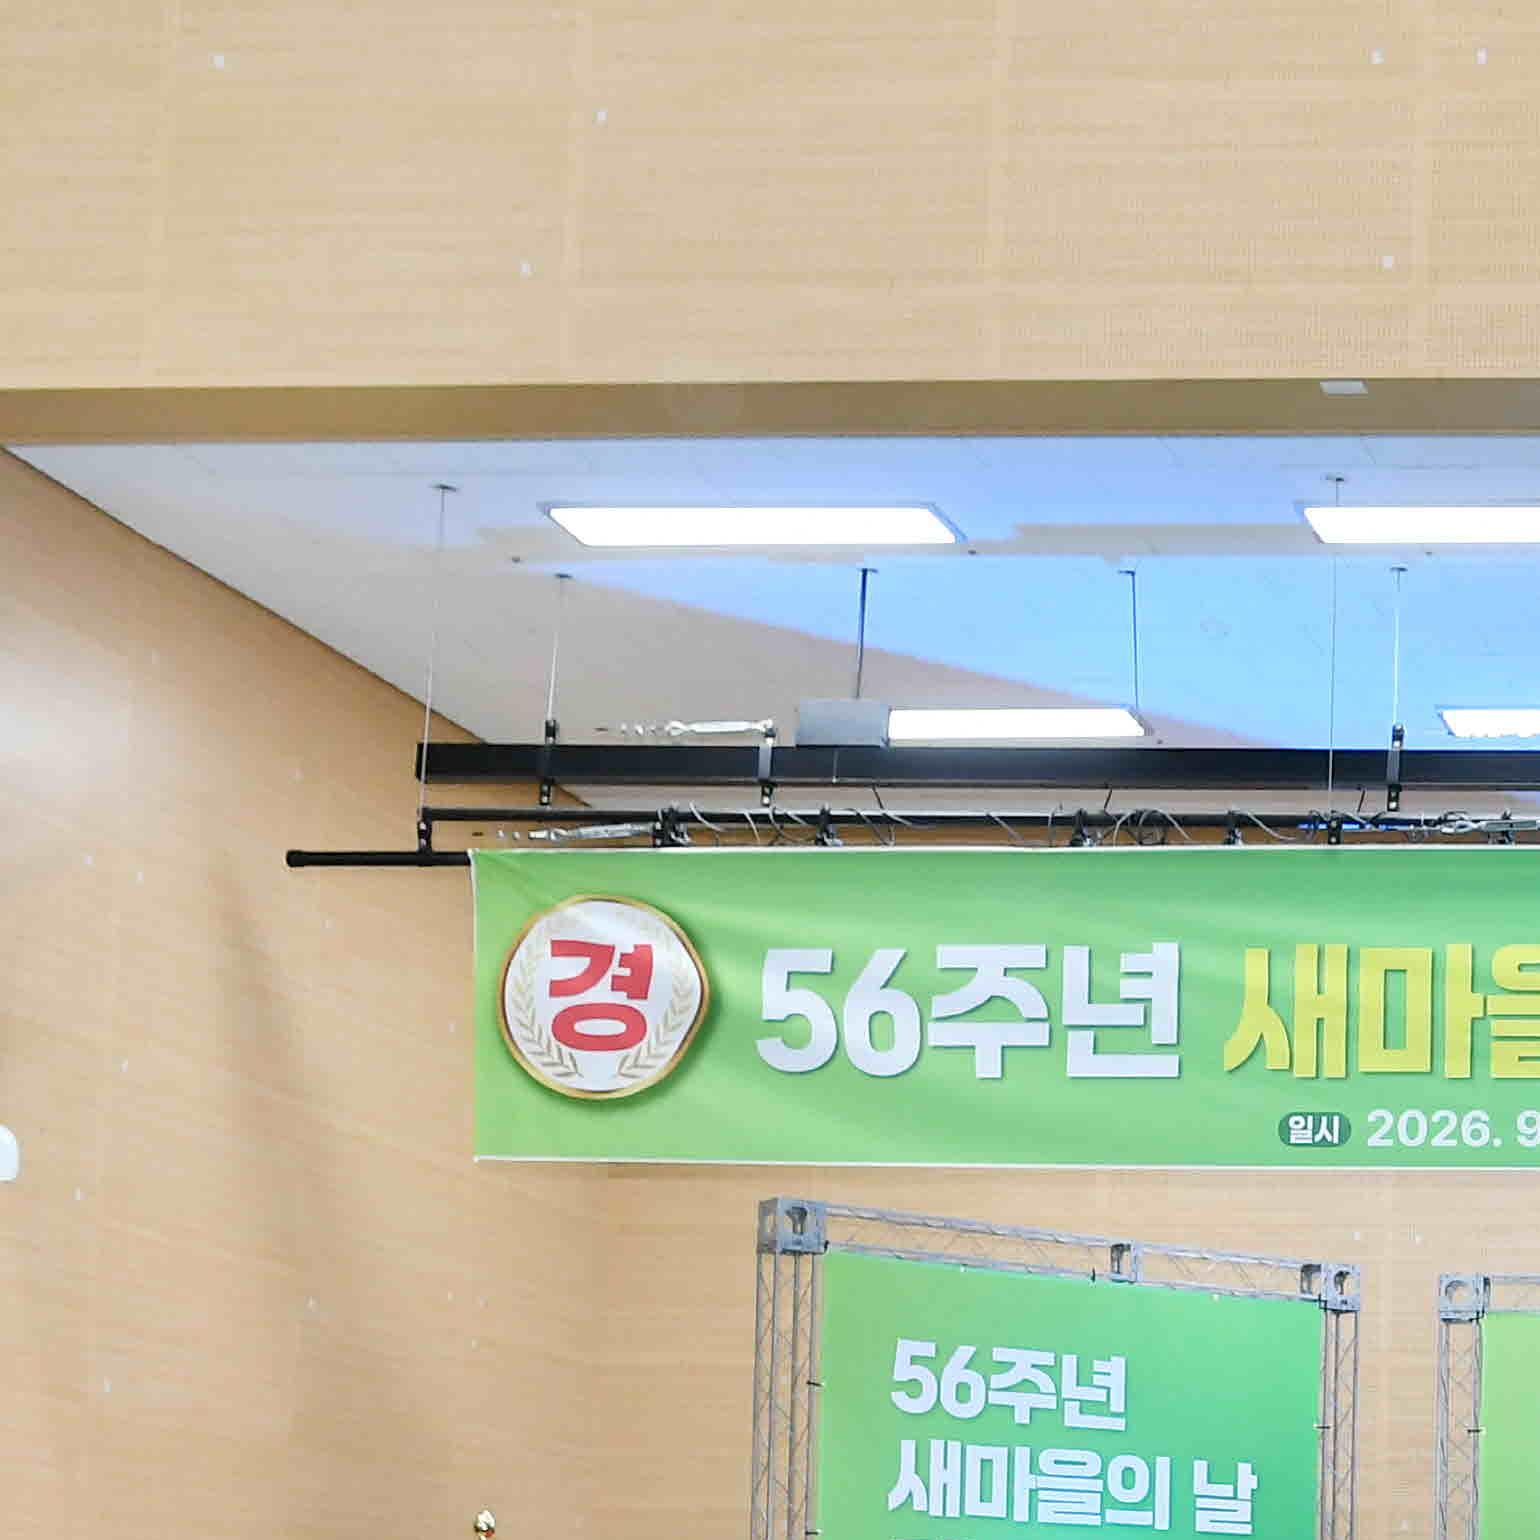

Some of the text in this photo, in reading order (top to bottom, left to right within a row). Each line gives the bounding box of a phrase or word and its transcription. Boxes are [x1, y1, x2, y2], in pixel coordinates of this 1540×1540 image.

[548, 938, 653, 1053] 경
[754, 942, 1181, 1080] 56주년
[1287, 1114, 1342, 1147] 일시
[1366, 1110, 1503, 1149] 2026.
[889, 1338, 1129, 1431] 56주년
[887, 1439, 1258, 1535] 새마을의 날
